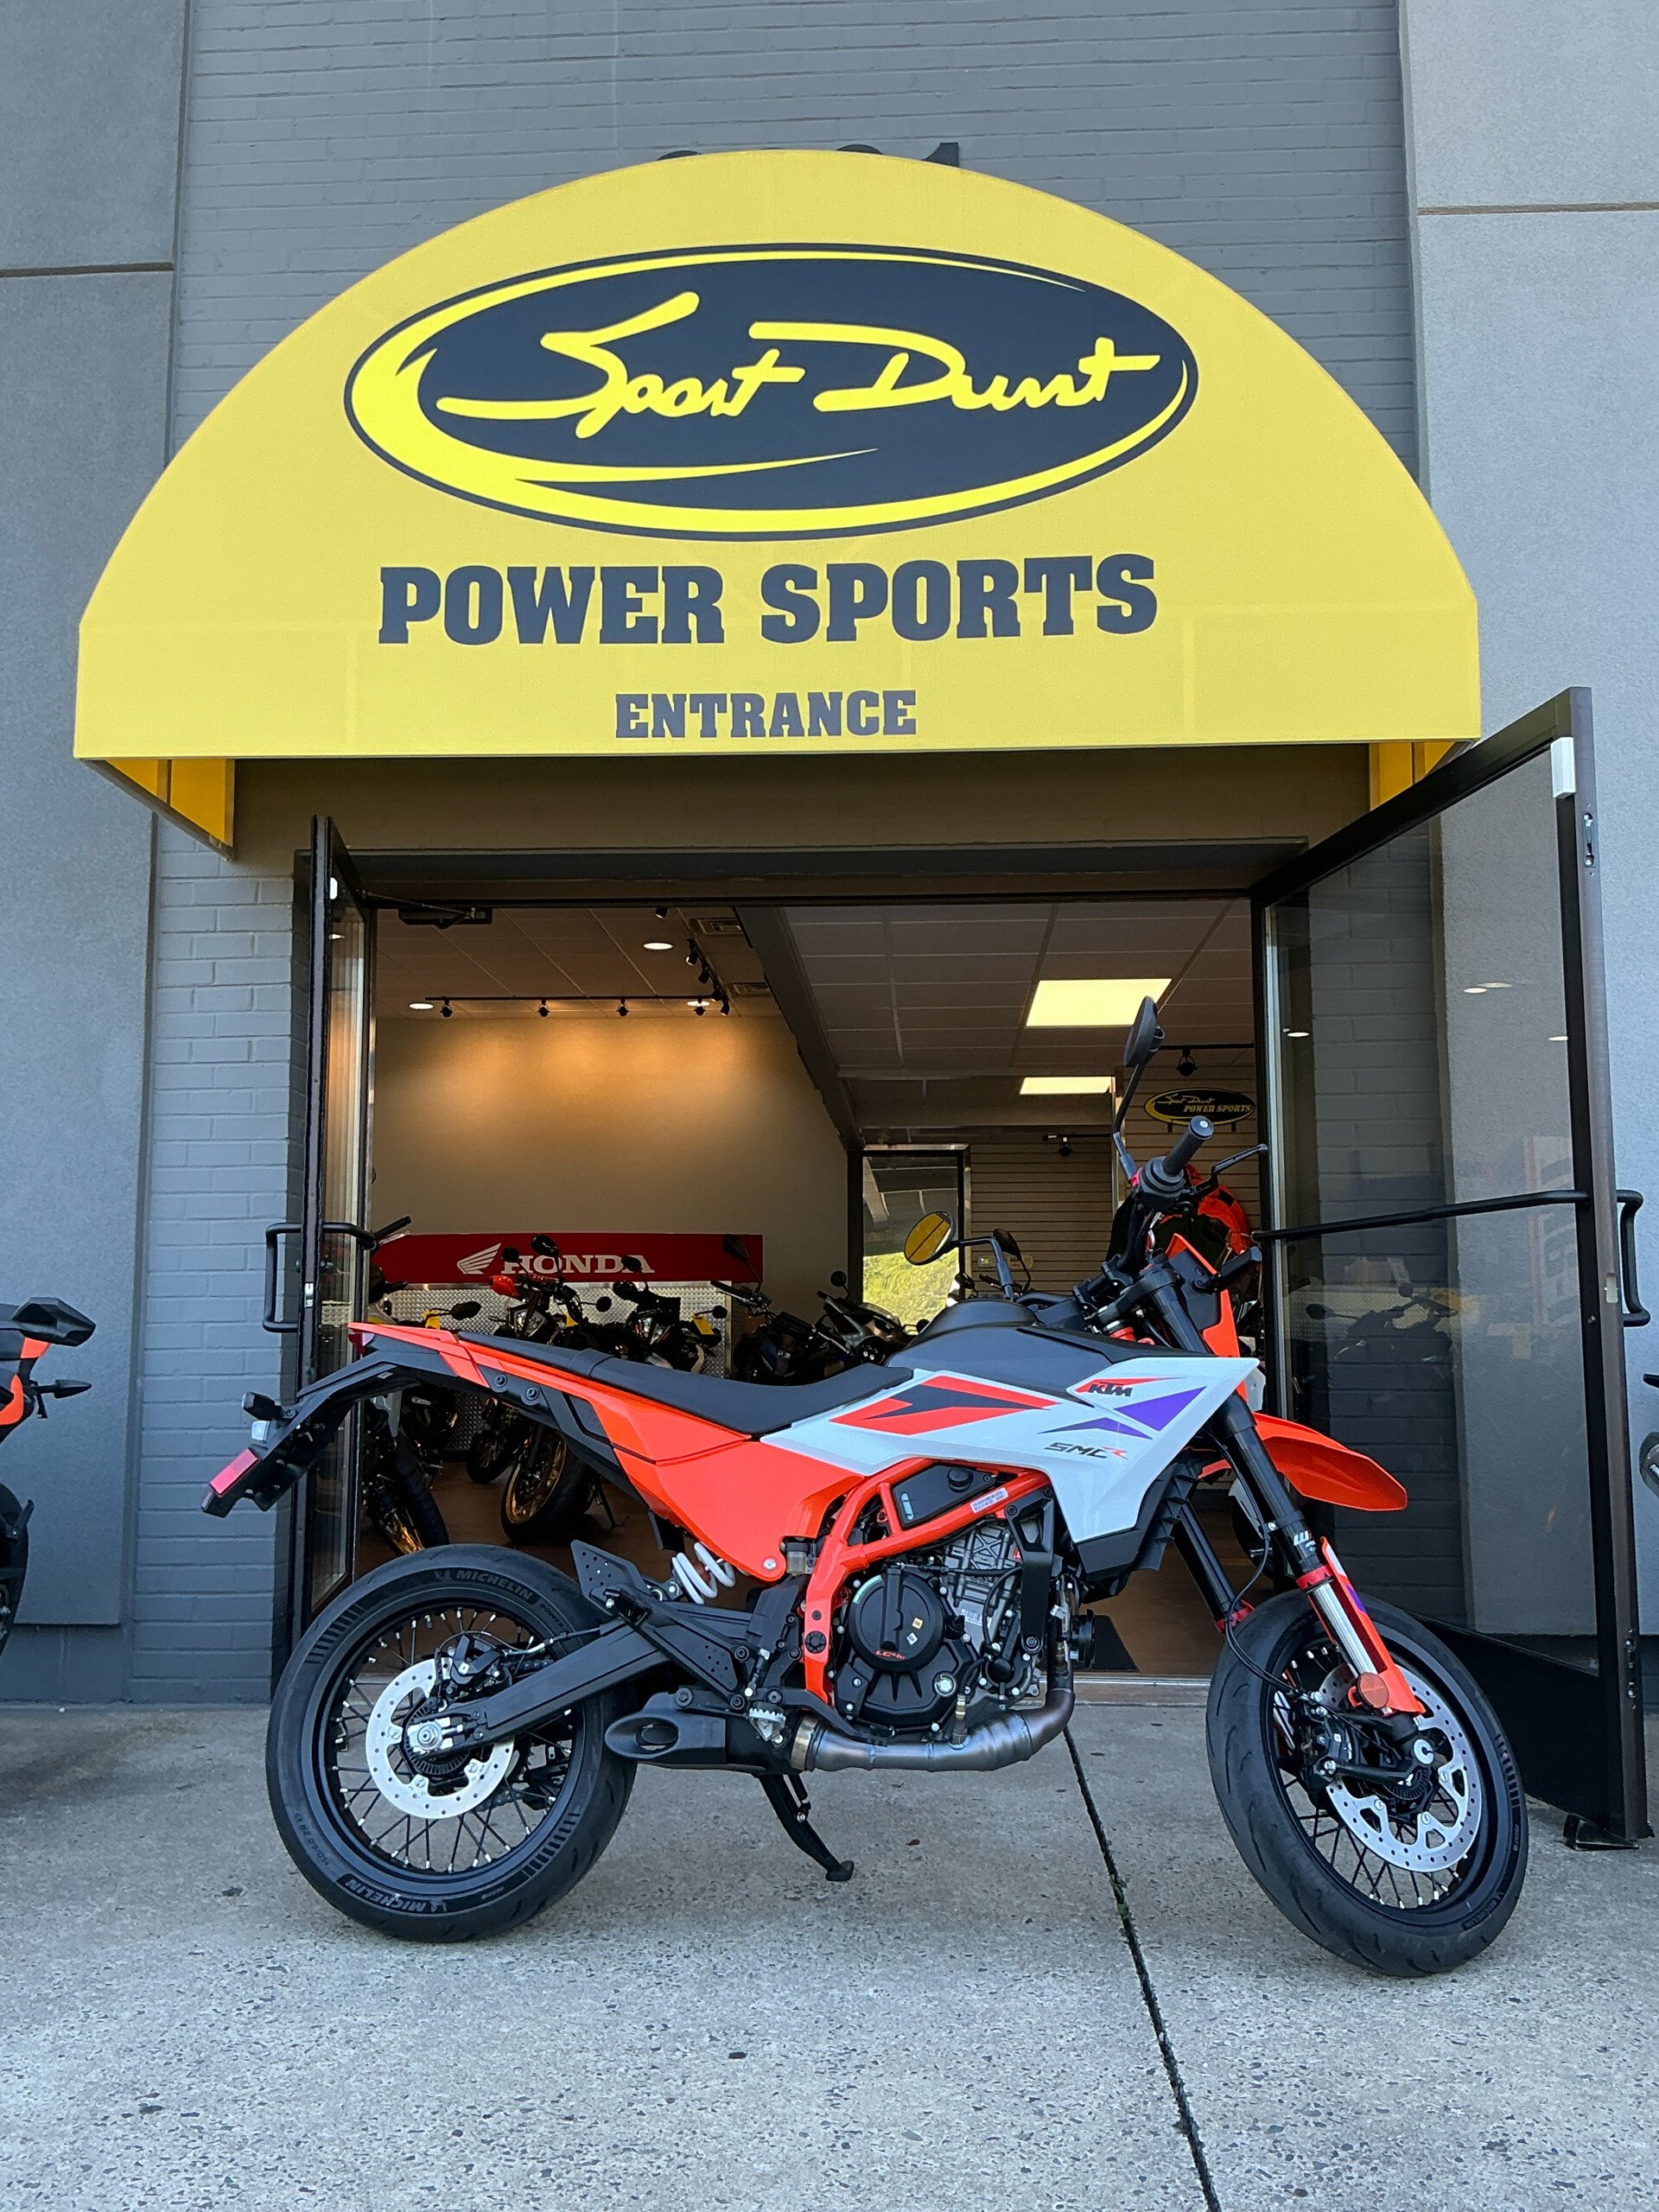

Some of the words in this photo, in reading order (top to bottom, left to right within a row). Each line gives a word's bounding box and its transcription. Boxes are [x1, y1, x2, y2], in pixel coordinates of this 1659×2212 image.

[378, 565, 725, 645] POWER
[760, 554, 1158, 645] SPORTS
[615, 690, 917, 739] ENTRANCE
[1183, 1104, 1216, 1113] POWER
[1216, 1104, 1252, 1113] SPORTS
[501, 1255, 655, 1274] HONDA
[1087, 1382, 1134, 1397] KTM
[455, 1569, 534, 1600] MICHELIN
[346, 1878, 428, 1912] MICHELIN
